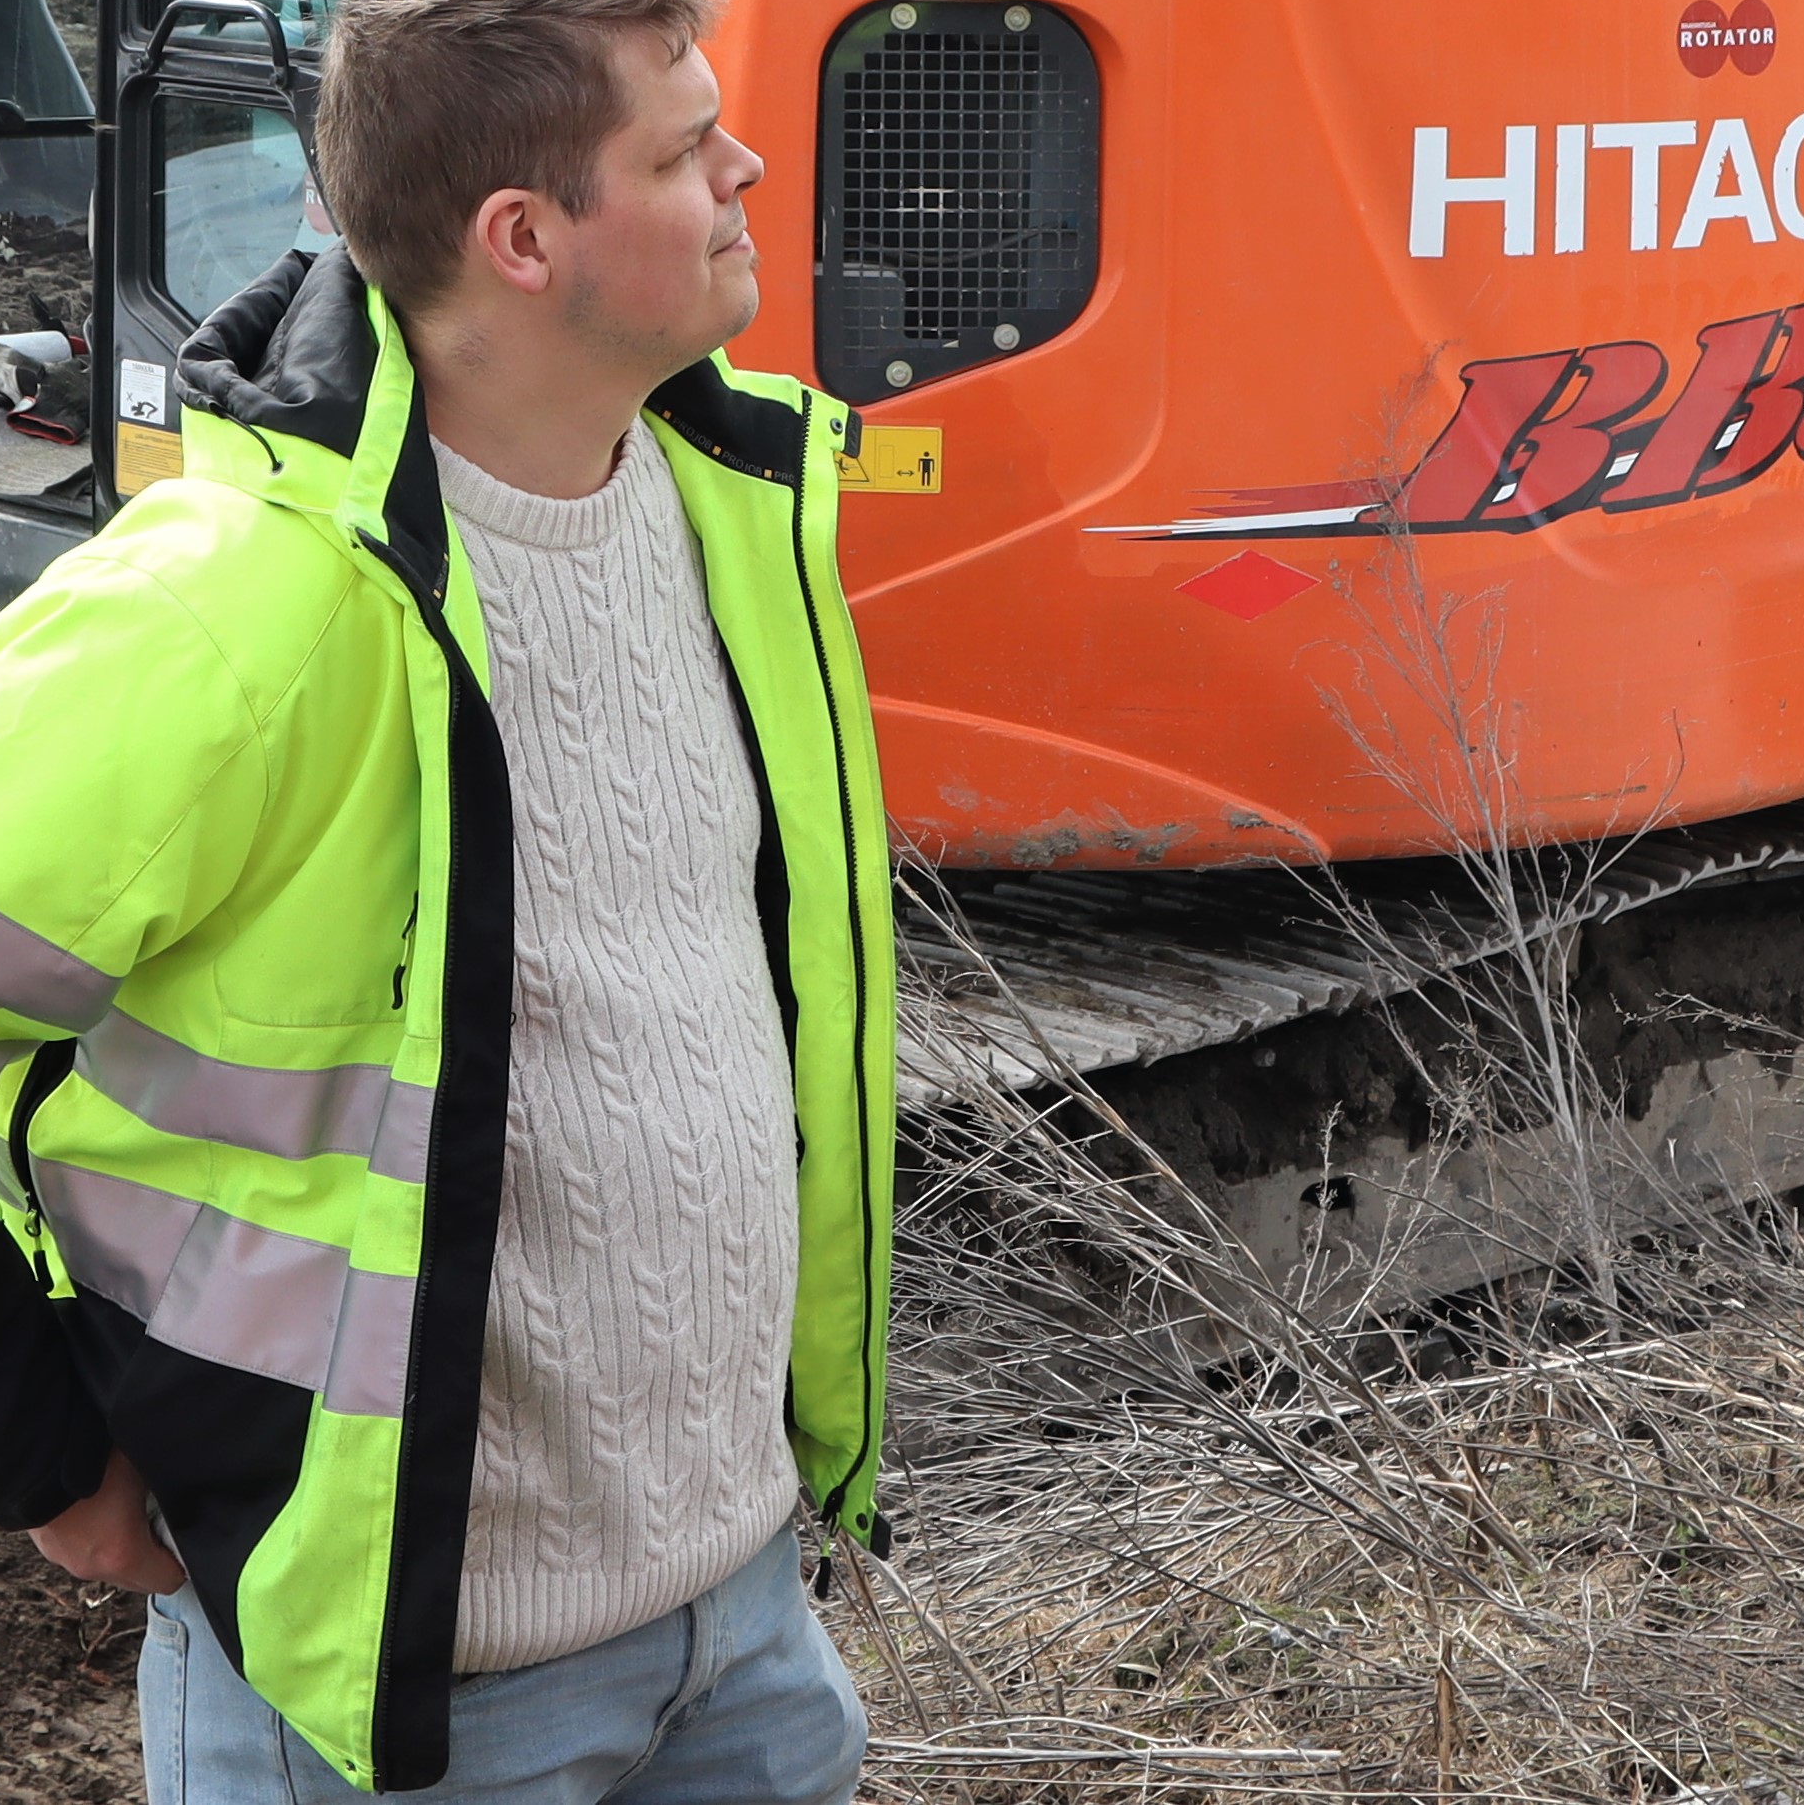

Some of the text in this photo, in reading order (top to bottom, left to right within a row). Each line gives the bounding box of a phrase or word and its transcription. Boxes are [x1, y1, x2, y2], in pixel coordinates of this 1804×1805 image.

[1680, 27, 1774, 48] ROTATOR
[672, 416, 714, 451] PROJOB
[722, 450, 763, 477] PROJOB
